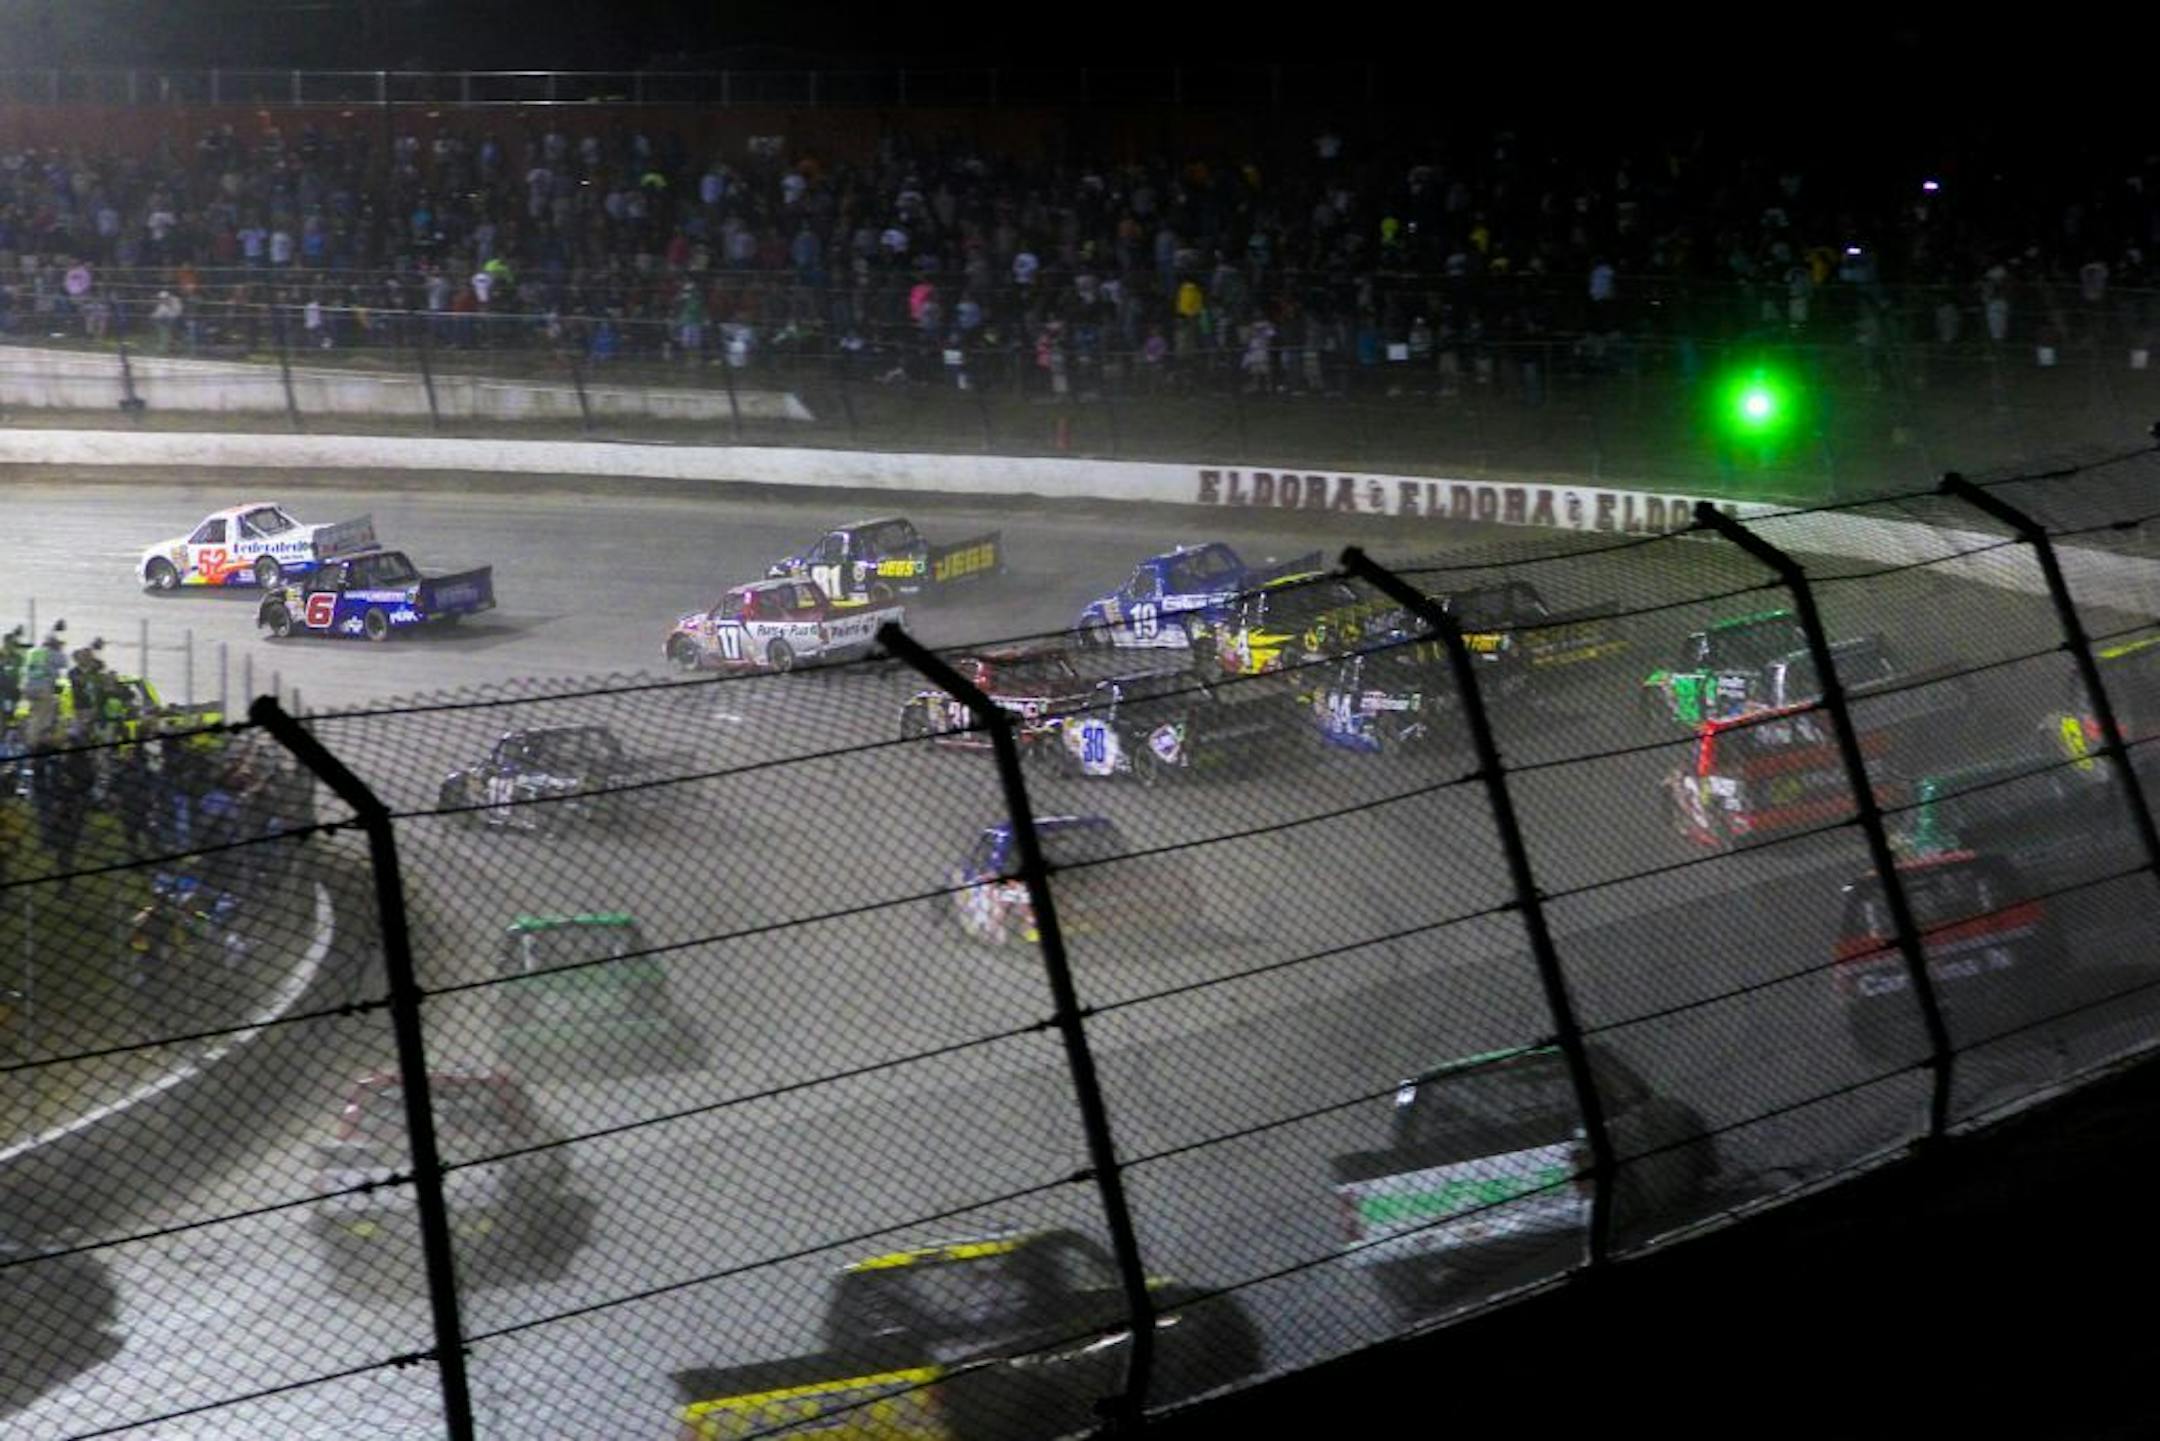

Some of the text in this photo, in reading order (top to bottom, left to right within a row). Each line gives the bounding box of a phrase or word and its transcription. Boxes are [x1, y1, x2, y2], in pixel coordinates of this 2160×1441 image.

[1199, 470, 1738, 537] ELDORA ELDORA ELDO
[198, 548, 228, 576] 52
[876, 560, 914, 578] JEGS
[936, 543, 995, 582] JEGS
[306, 592, 336, 628] 6
[1129, 602, 1158, 640] 19
[1083, 727, 1106, 763] 30
